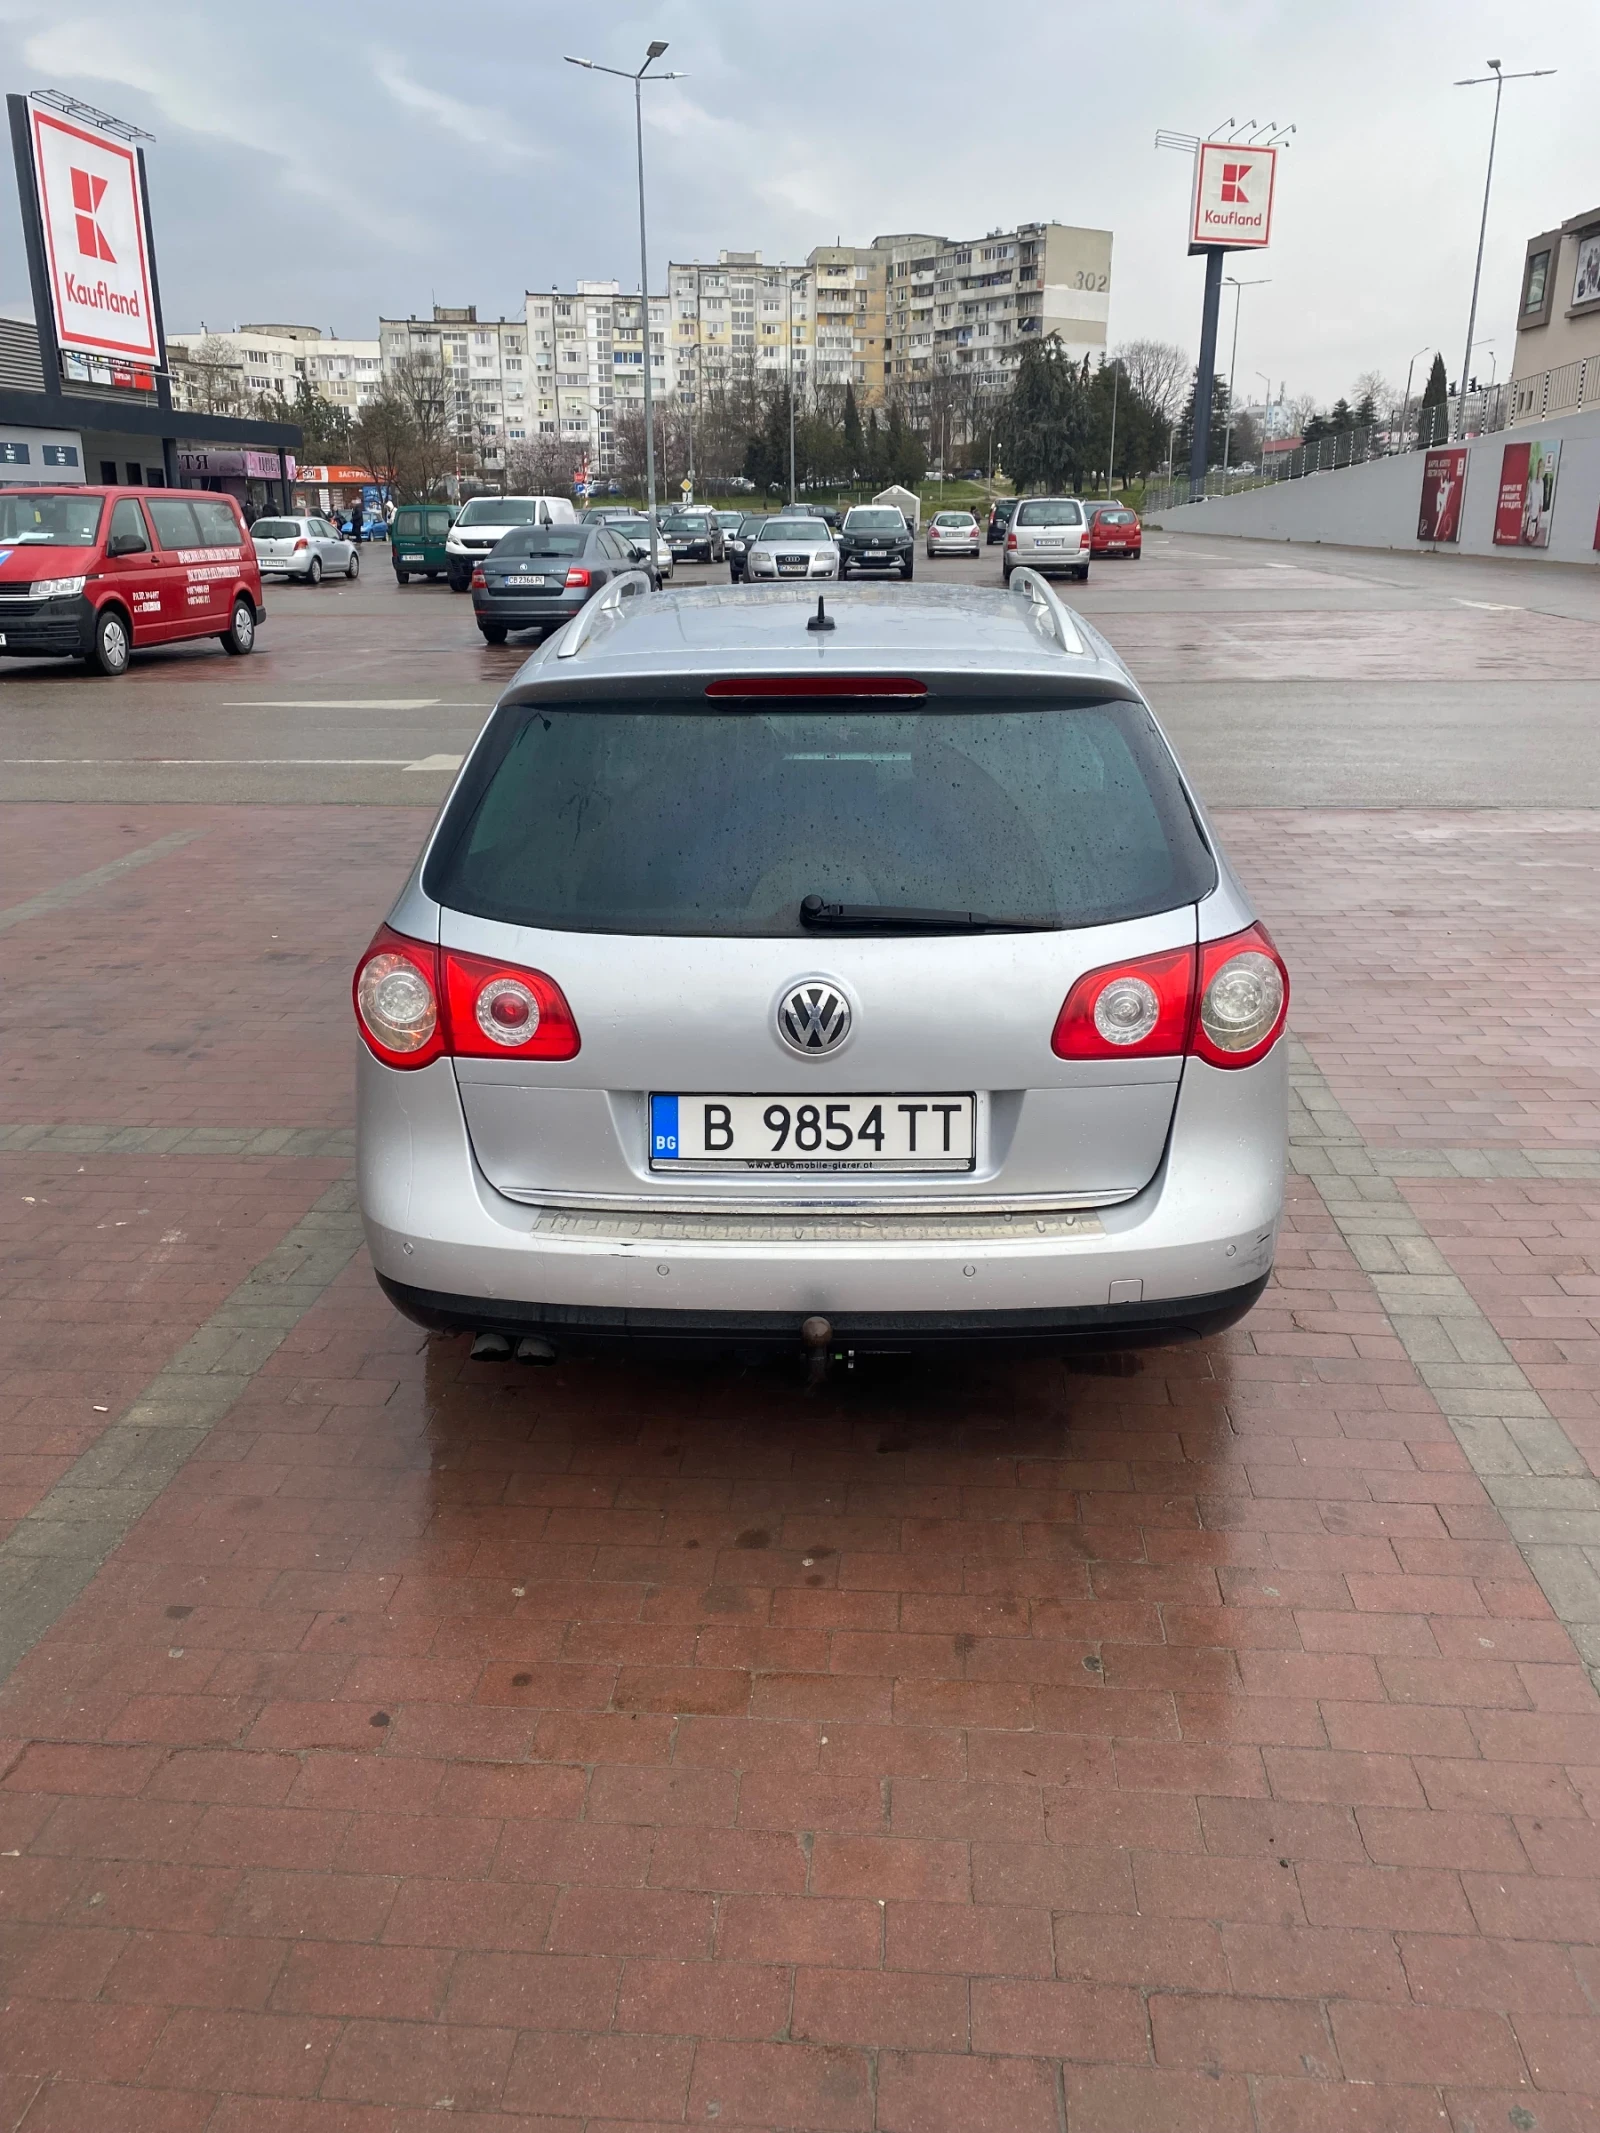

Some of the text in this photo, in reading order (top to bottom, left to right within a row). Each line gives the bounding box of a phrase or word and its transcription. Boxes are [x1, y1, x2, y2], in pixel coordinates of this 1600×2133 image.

[1204, 209, 1262, 227] Kaufland
[1074, 270, 1108, 292] 302
[64, 271, 140, 318] Kaufland
[704, 1104, 962, 1151] B 9854 TT
[656, 1135, 677, 1150] BG
